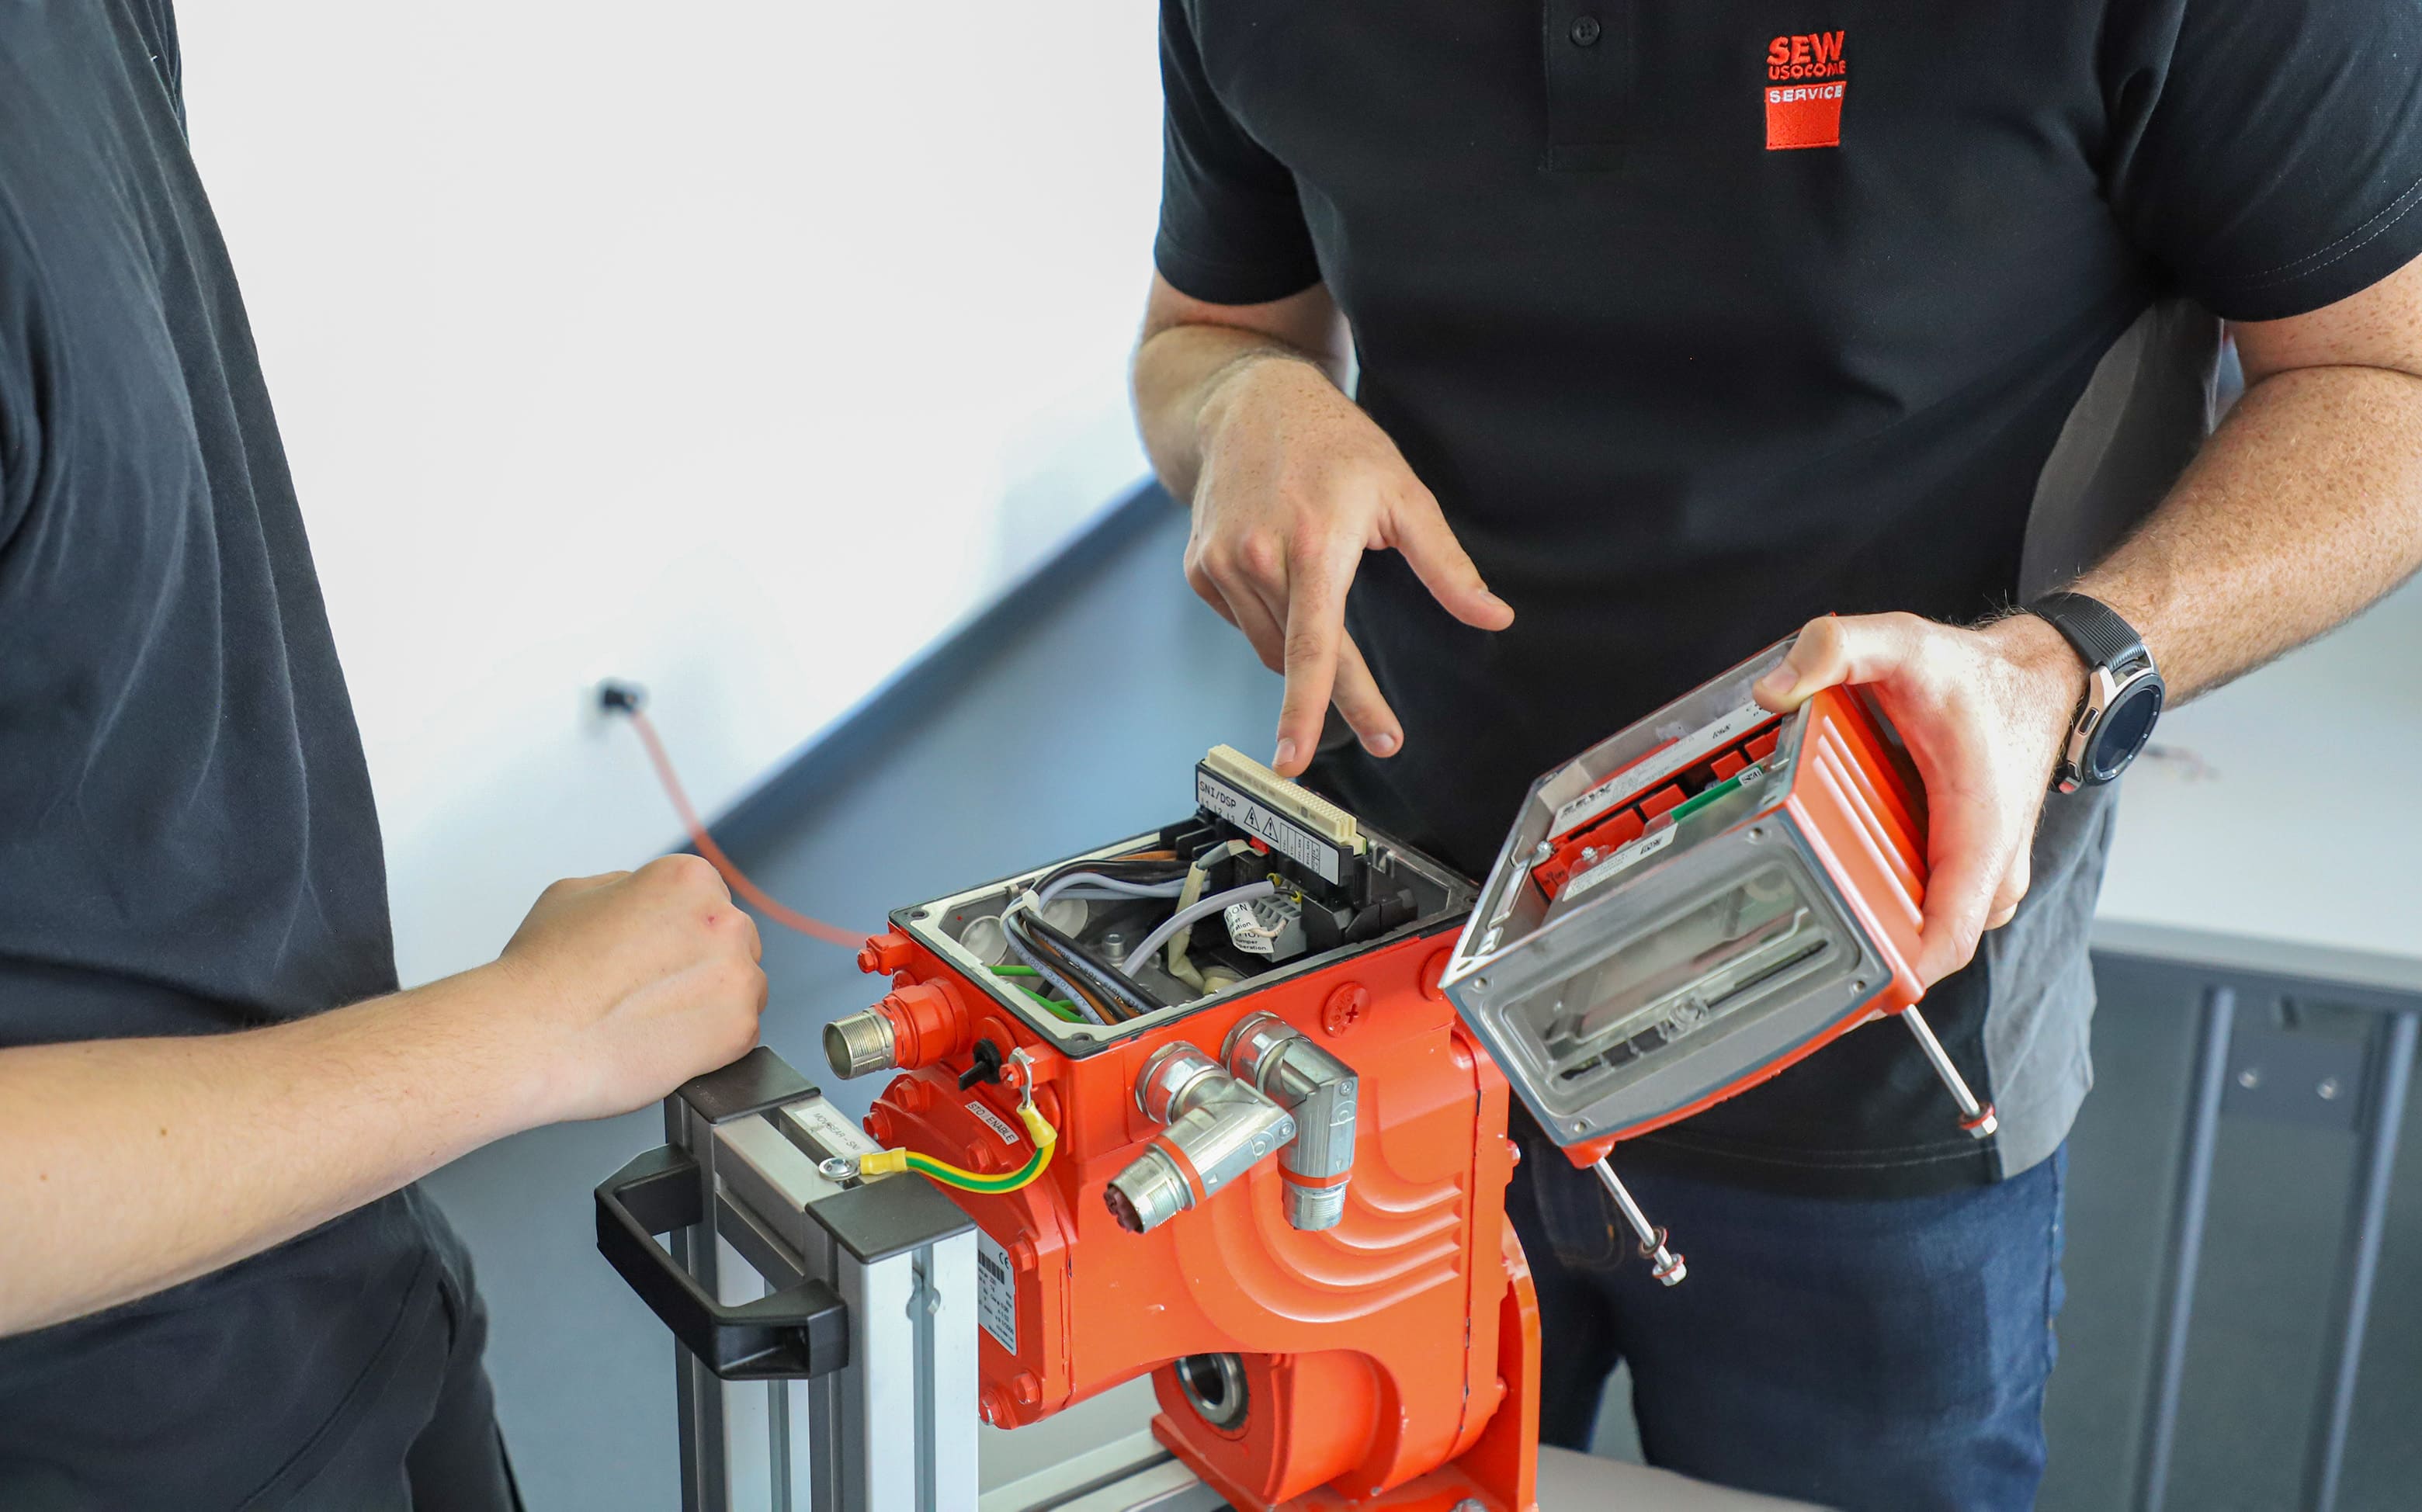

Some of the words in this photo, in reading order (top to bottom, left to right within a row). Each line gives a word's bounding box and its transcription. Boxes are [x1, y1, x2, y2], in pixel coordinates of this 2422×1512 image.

[1767, 31, 1844, 65] SEW
[1768, 60, 1846, 80] USOCOME
[1769, 85, 1843, 103] SERVICE
[1199, 781, 1237, 808] SNI/DSP
[967, 1103, 985, 1116] STO
[986, 1116, 1015, 1141] ENABLE
